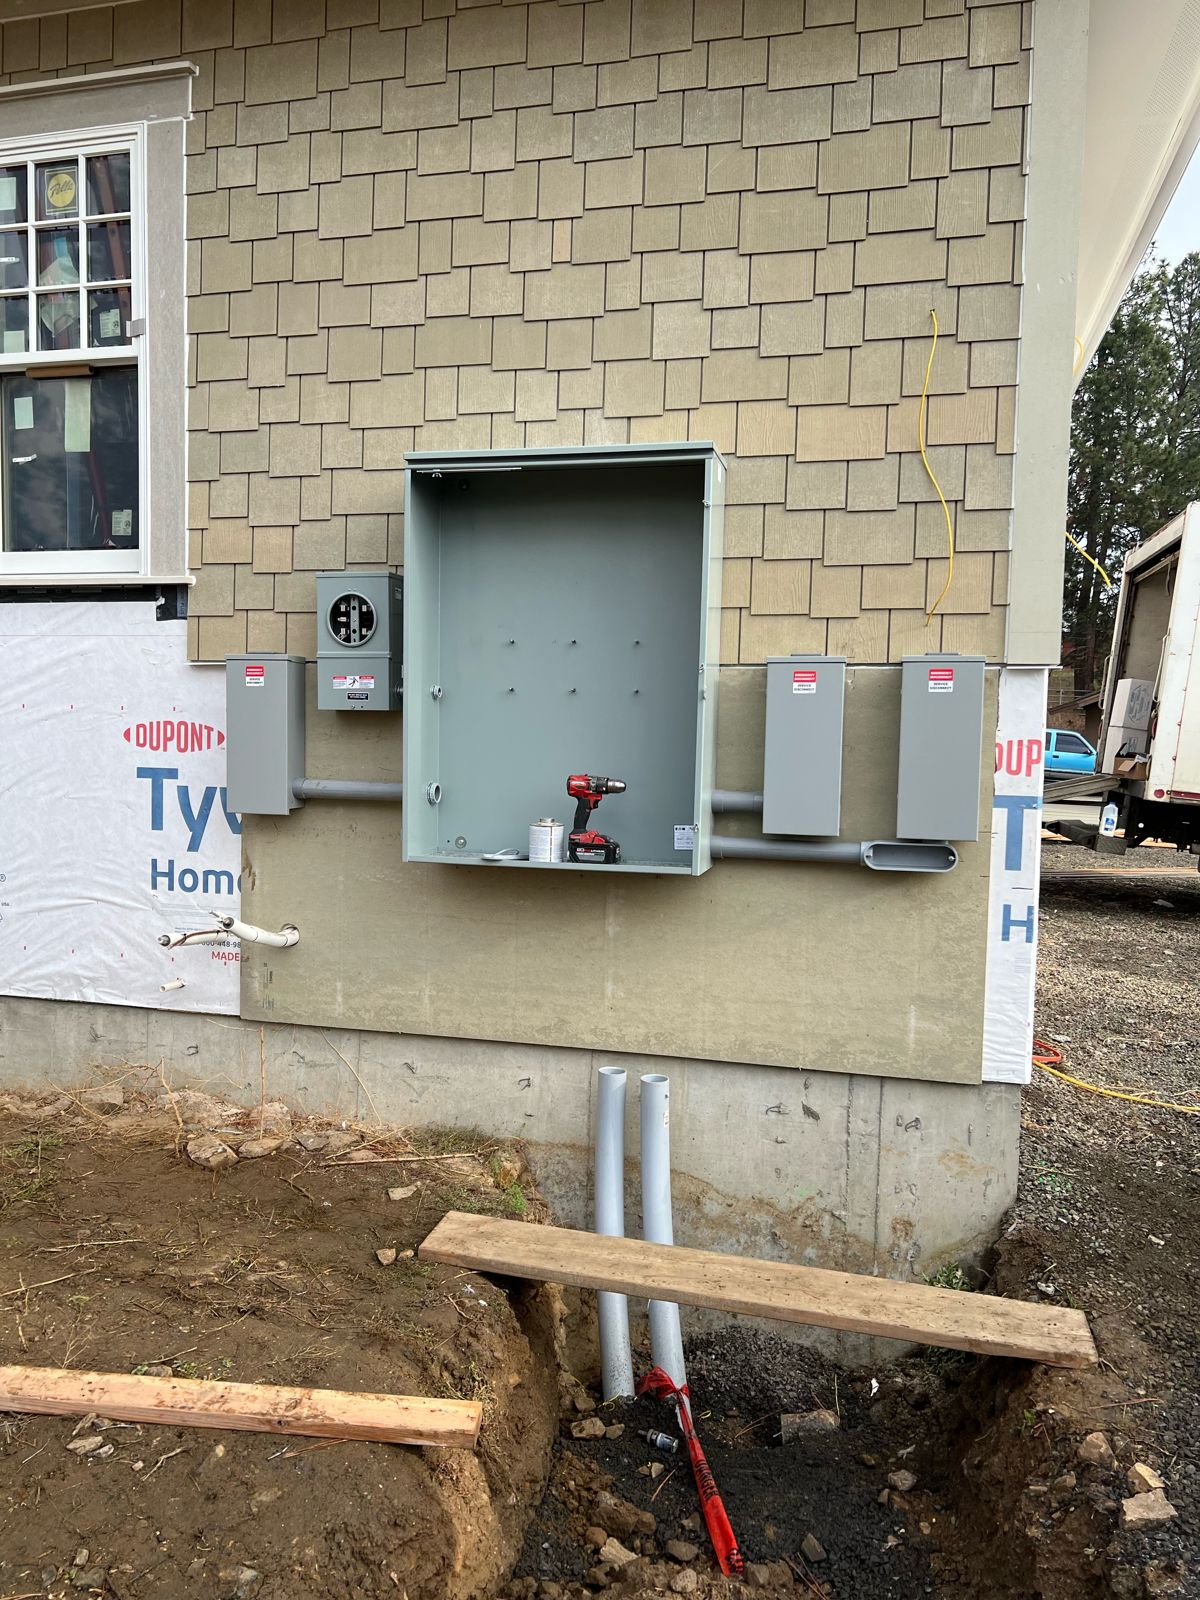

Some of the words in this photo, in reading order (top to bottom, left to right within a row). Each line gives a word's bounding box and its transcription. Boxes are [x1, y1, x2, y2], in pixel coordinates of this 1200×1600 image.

[135, 720, 214, 753] DUPONT
[151, 858, 241, 895] Hom
[1001, 904, 1034, 943] H
[211, 951, 240, 961] MADE
